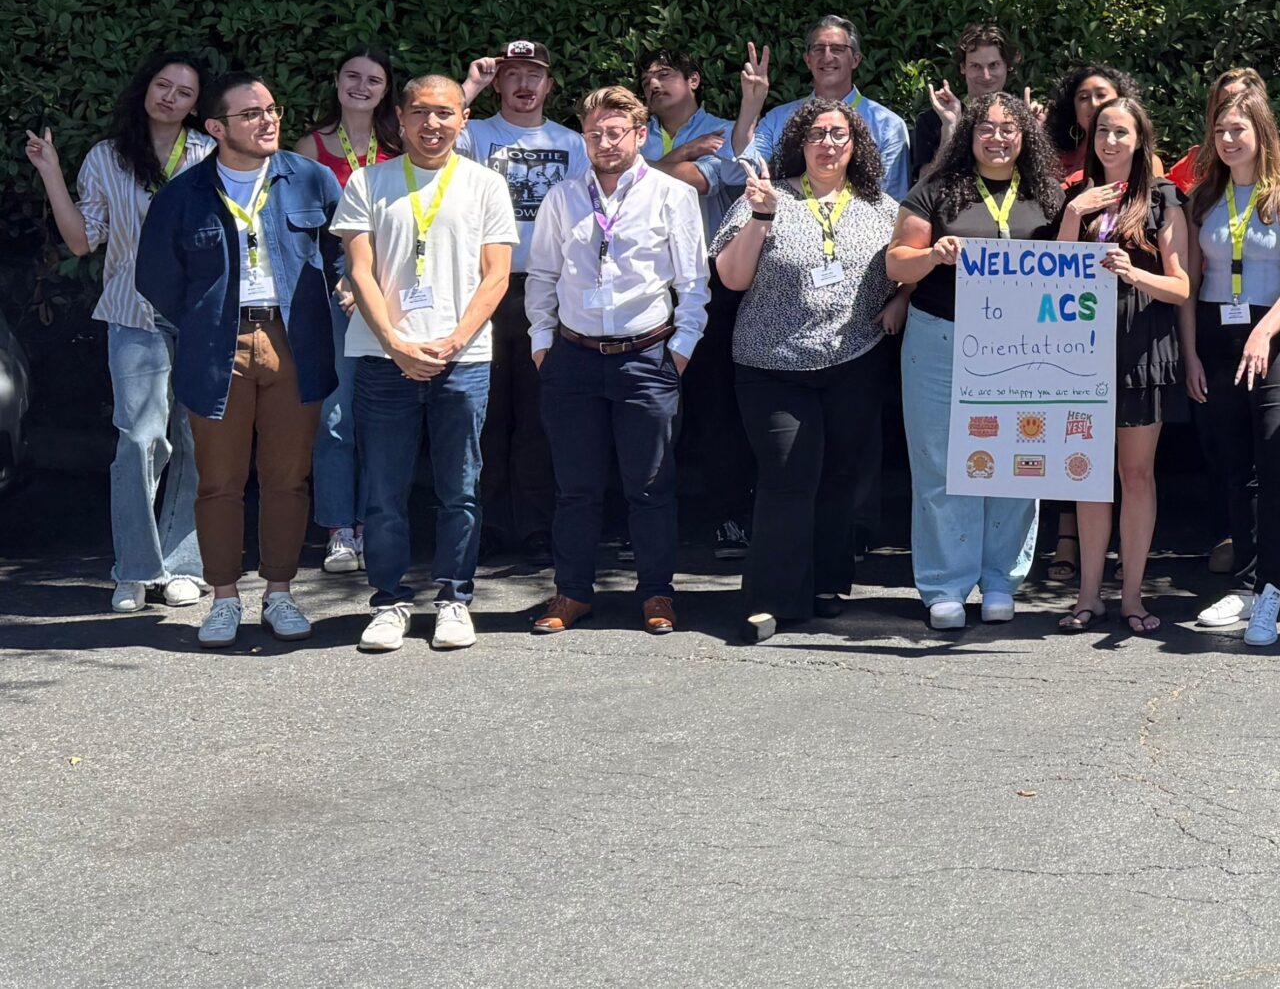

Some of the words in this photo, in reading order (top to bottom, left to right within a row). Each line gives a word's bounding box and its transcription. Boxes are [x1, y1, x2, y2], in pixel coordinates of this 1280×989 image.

[960, 246, 1097, 280] WELCOME
[980, 296, 1003, 321] to
[1036, 291, 1098, 323] ACS
[962, 330, 1095, 358] Orientation!
[959, 386, 973, 397] We
[978, 388, 991, 396] are
[996, 388, 1006, 396] so
[1008, 385, 1033, 399] happy
[1037, 388, 1051, 399] you
[1055, 388, 1068, 396] are
[1072, 385, 1090, 396] here
[1066, 410, 1093, 425] HECK
[1067, 421, 1088, 434] YES!
